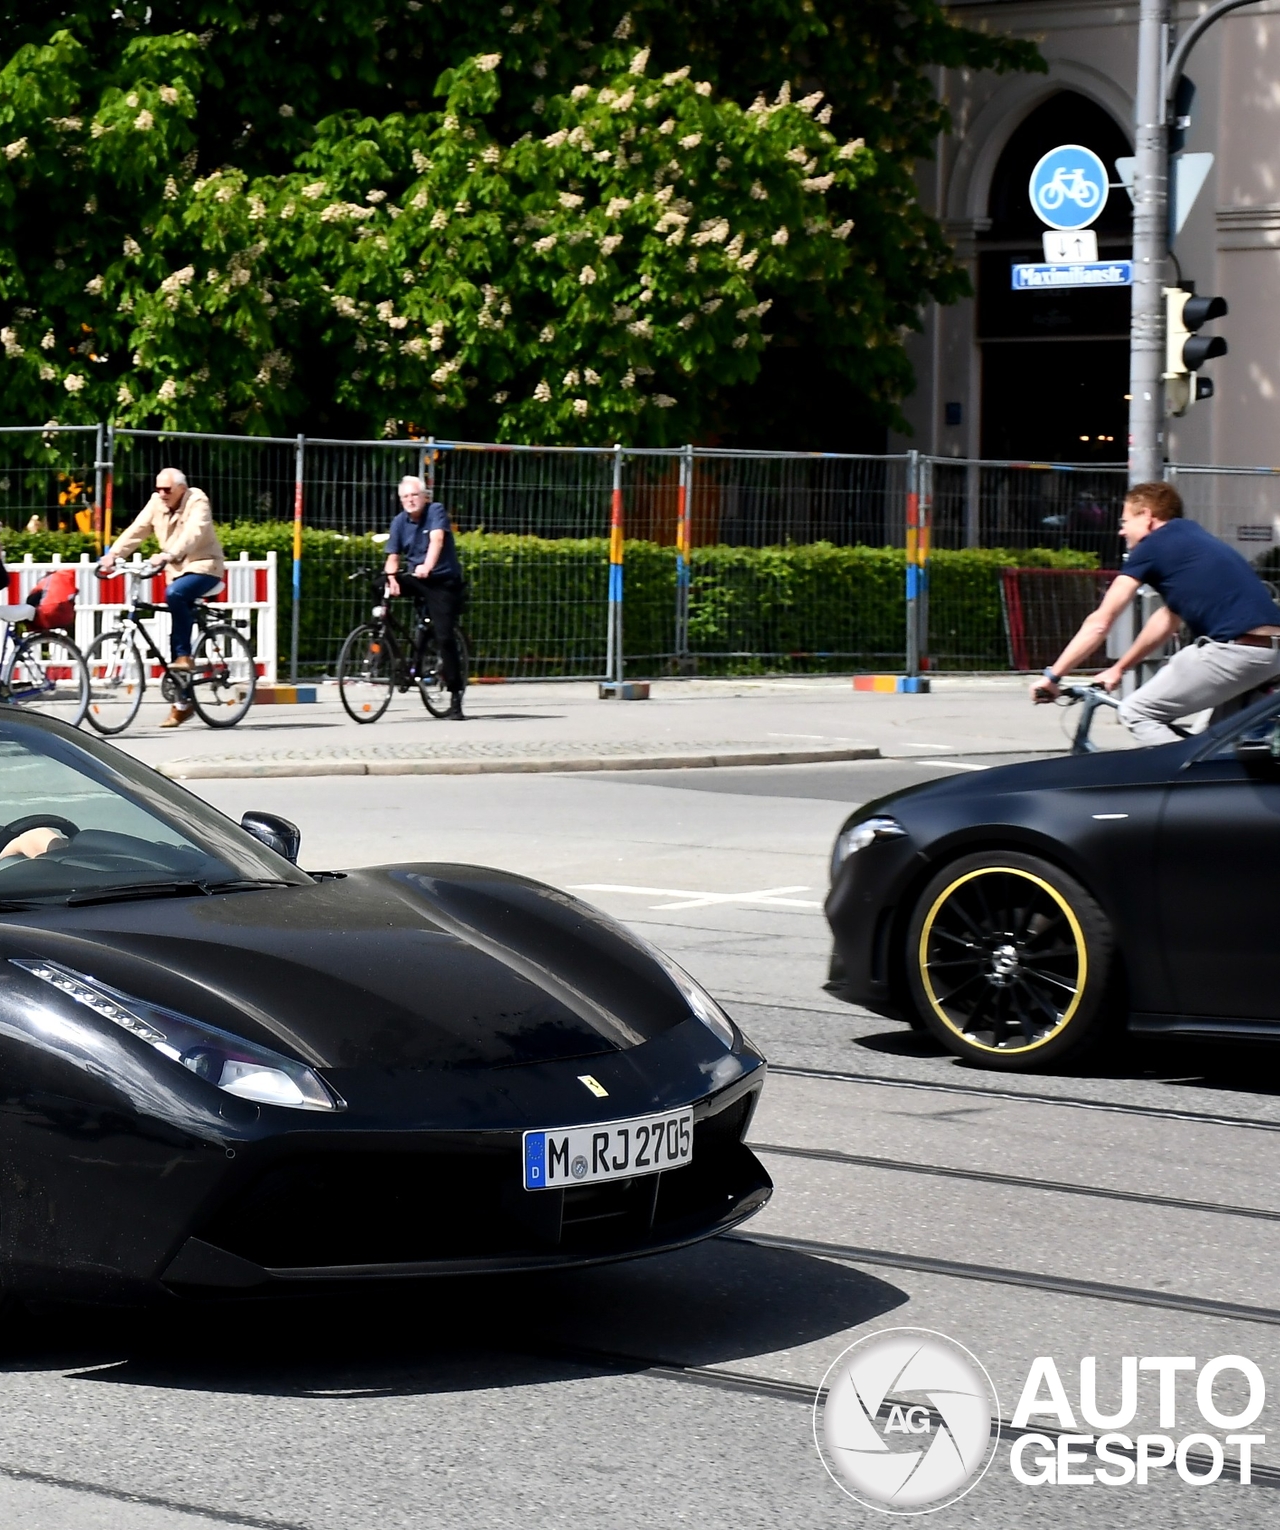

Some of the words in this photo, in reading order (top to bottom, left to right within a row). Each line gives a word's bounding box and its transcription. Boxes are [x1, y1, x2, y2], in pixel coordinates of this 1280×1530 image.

[1020, 265, 1125, 286] Maximilianstr.
[531, 1166, 540, 1179] D
[548, 1137, 569, 1179] M
[592, 1129, 629, 1174] RJ
[635, 1116, 691, 1167] 2705
